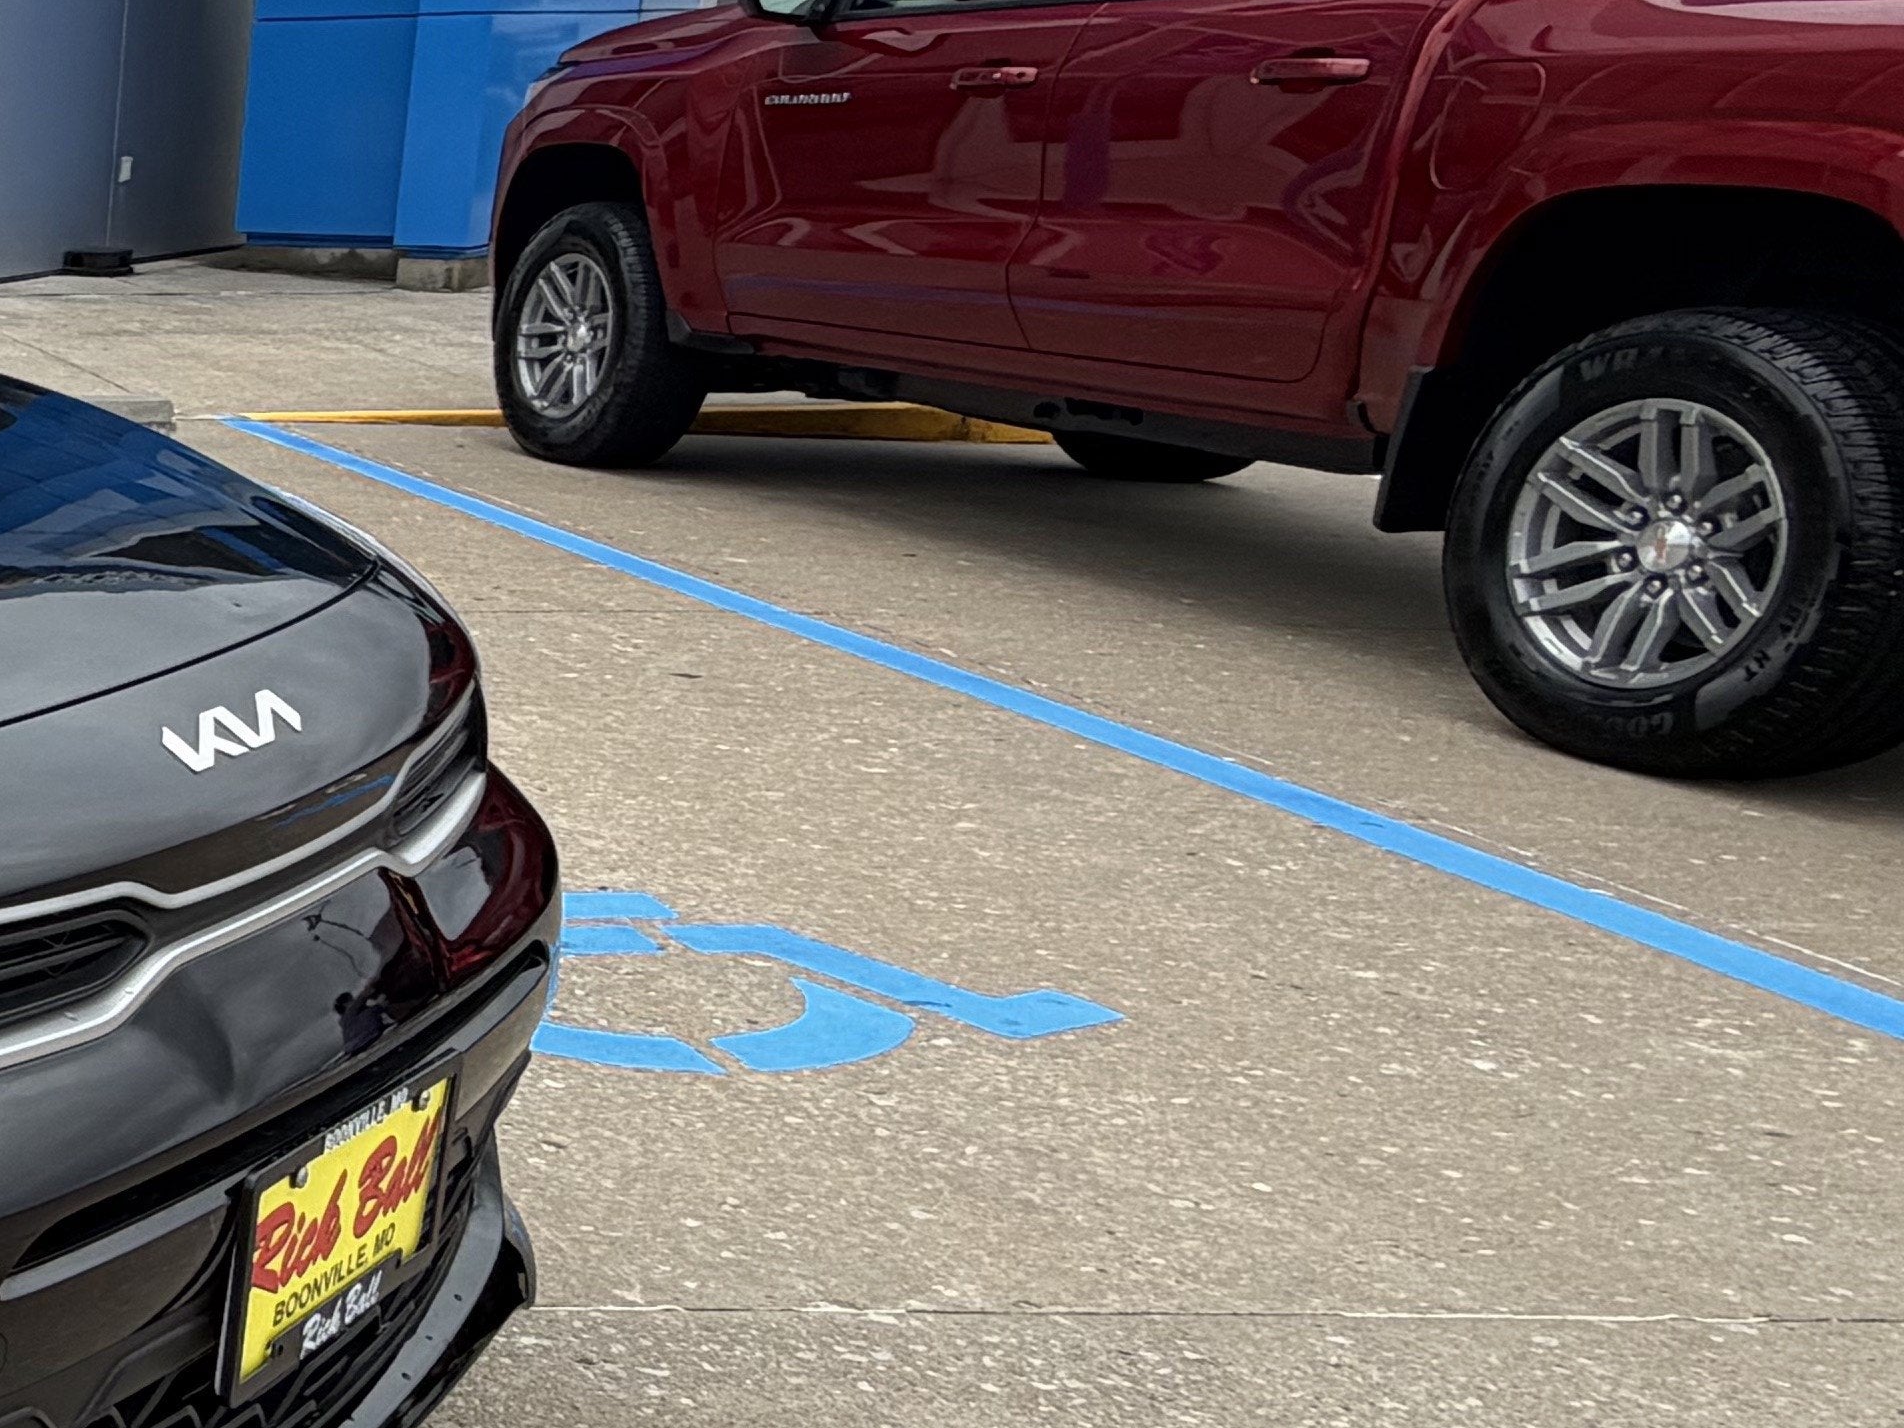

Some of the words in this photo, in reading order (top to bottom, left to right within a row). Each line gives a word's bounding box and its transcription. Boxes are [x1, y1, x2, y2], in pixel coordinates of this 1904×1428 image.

[161, 688, 301, 773] KIA
[252, 1169, 348, 1294] Rick
[353, 1106, 443, 1240] Ball
[273, 1246, 369, 1328] BOONVILLE,
[373, 1222, 396, 1258] MO
[299, 1297, 343, 1361] Rick
[344, 1270, 383, 1324] Ball
